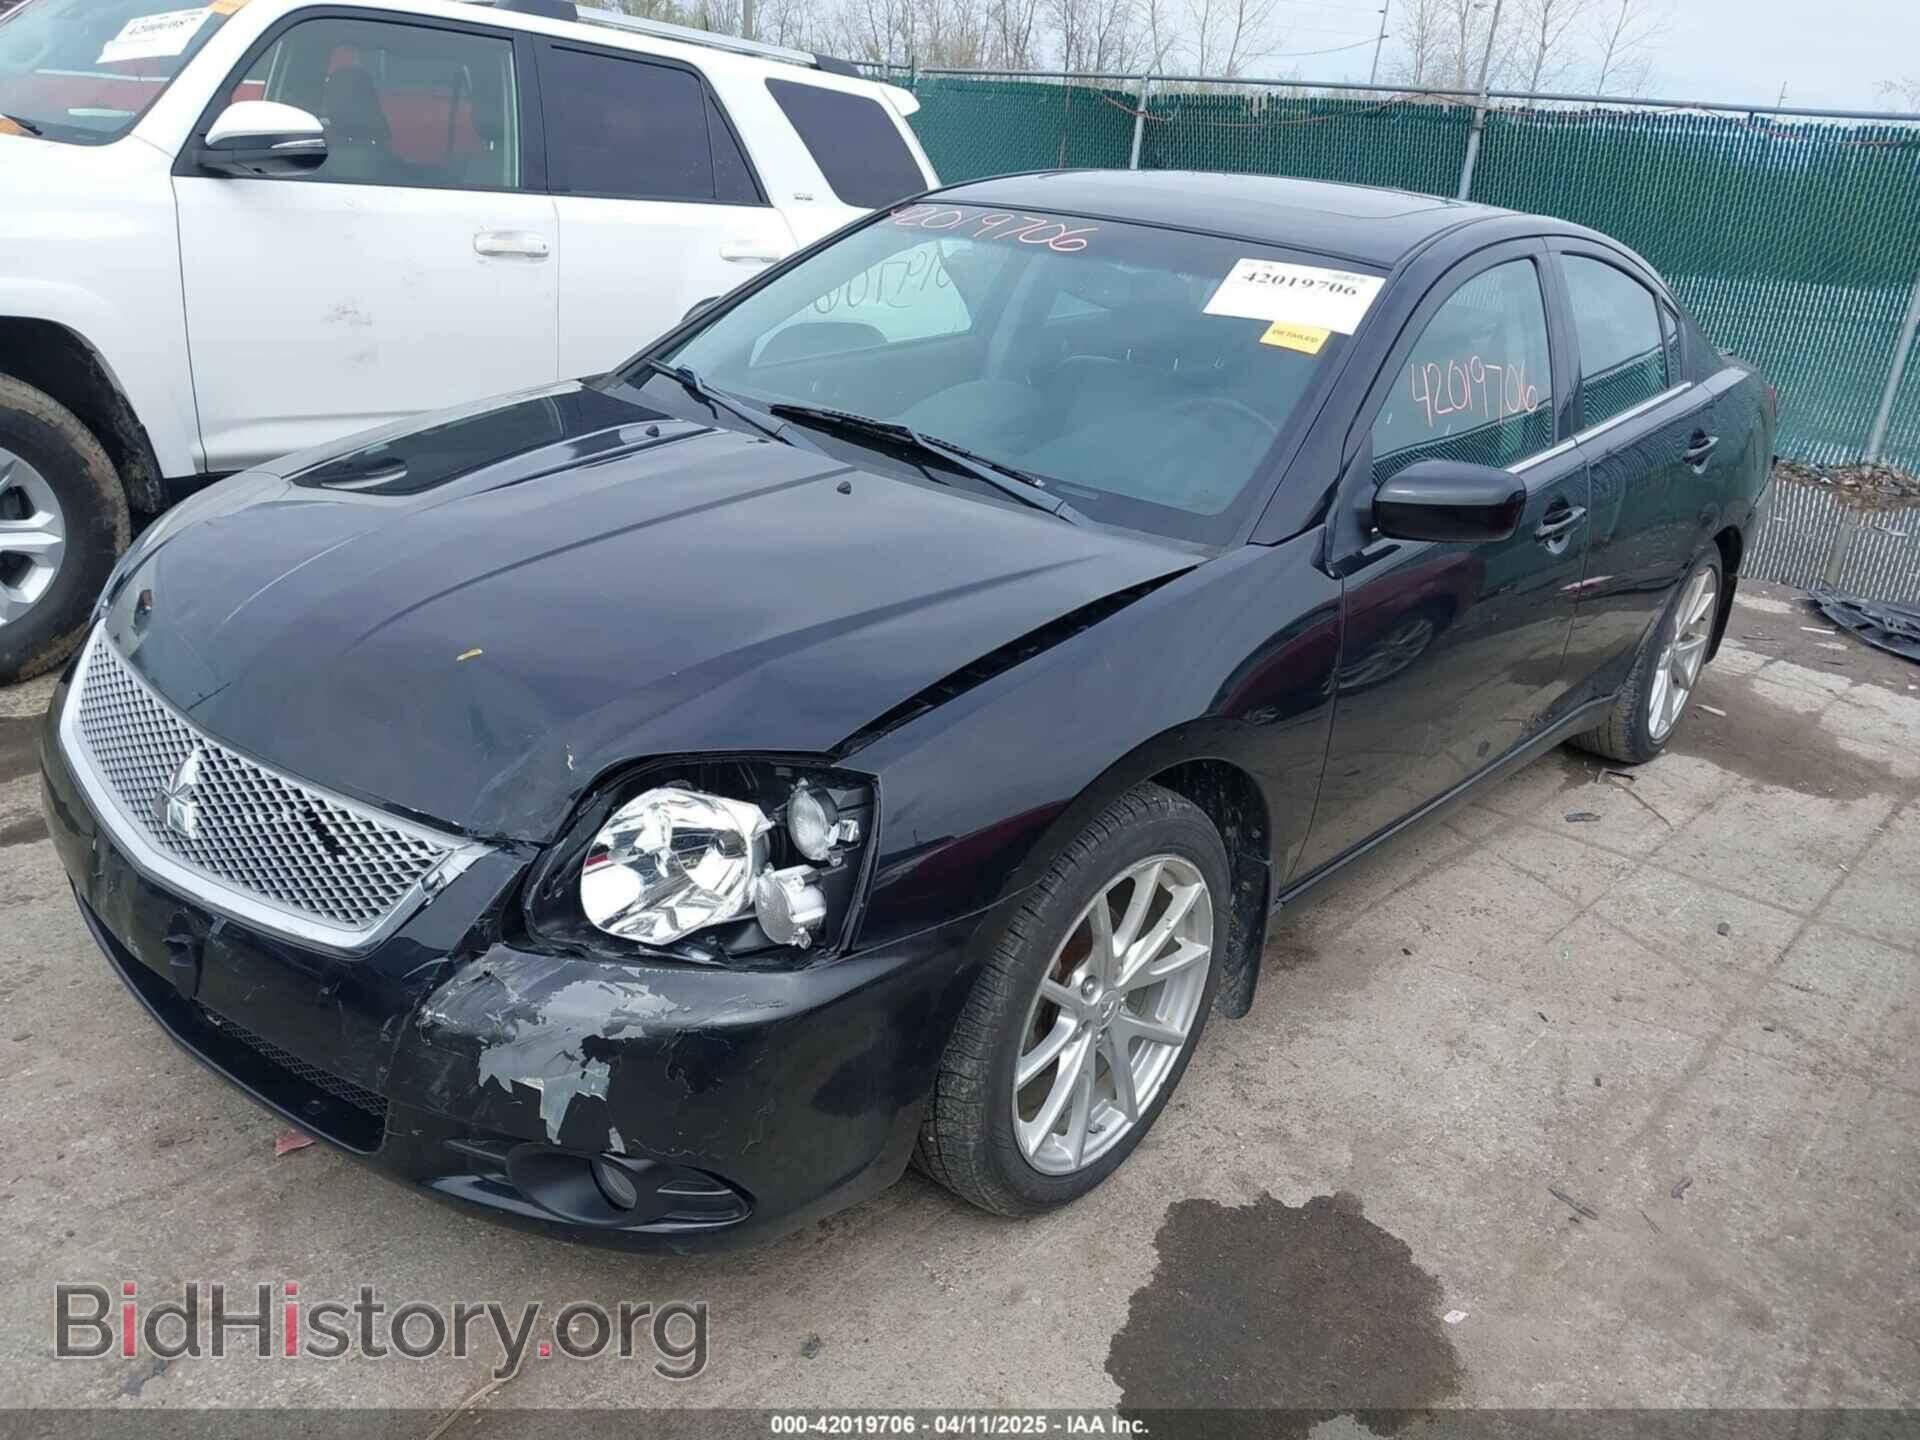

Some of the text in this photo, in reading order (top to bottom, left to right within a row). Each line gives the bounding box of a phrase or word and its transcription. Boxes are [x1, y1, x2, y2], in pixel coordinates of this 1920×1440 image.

[889, 204, 1099, 252] 42019706
[1242, 271, 1358, 297] 42019706
[1411, 355, 1539, 429] 42019706
